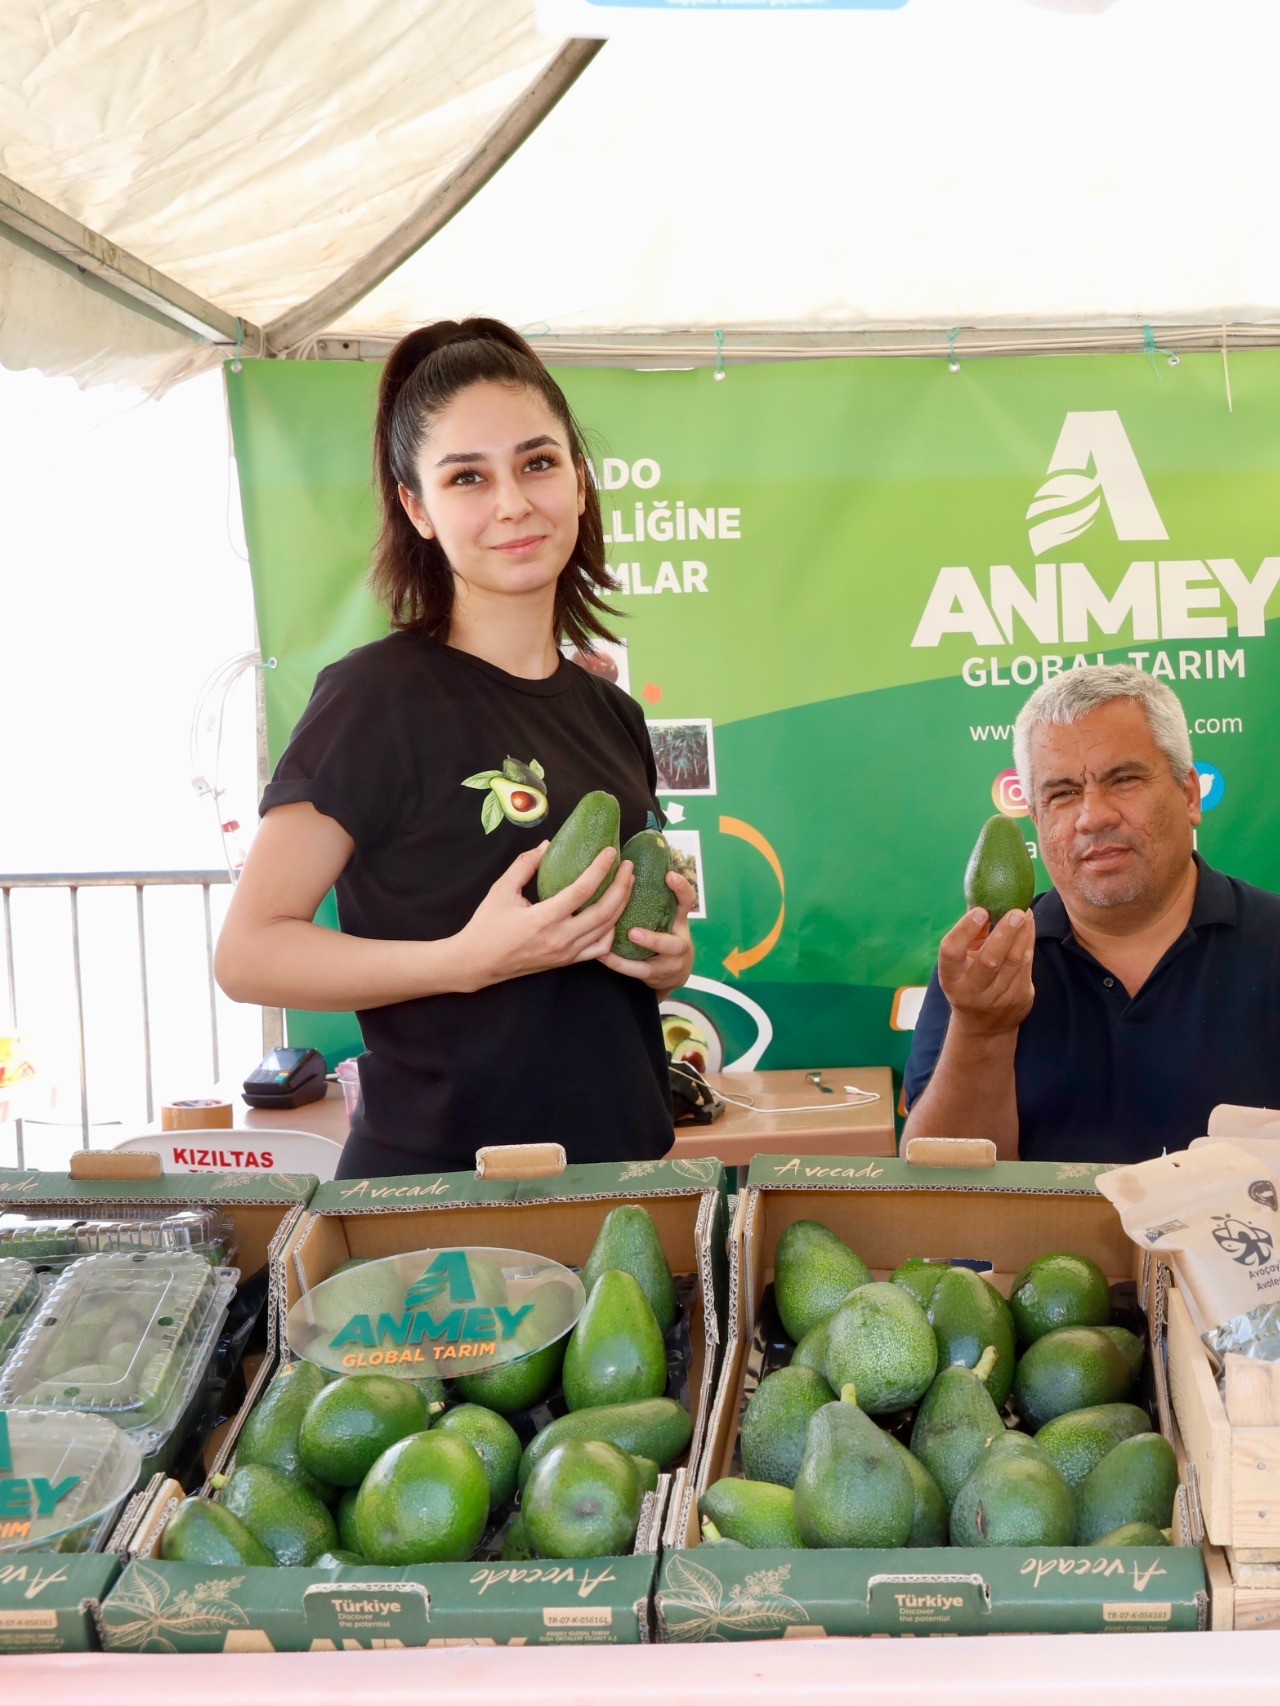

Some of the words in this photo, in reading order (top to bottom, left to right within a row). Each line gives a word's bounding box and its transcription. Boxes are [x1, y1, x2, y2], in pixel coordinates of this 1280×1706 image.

[1129, 648, 1246, 680] TARIM
[173, 1148, 274, 1171] KIZILTAS
[773, 1158, 884, 1179] Avocado
[340, 1177, 450, 1199] Avocado
[1248, 1261, 1280, 1279] Avoçay
[328, 1304, 535, 1349] ANMEY
[341, 1346, 424, 1367] GLOBAL
[433, 1341, 496, 1360] TARIM
[470, 1564, 617, 1598] Avocado
[1020, 1557, 1168, 1592] Avocado
[331, 1599, 402, 1615] Türkiye
[894, 1594, 964, 1610] Türkiye
[354, 1620, 391, 1629] potential
[547, 1616, 610, 1624] TR-07-K-056161
[914, 1615, 951, 1623] potential
[1107, 1611, 1167, 1619] TR-07-K-056161
